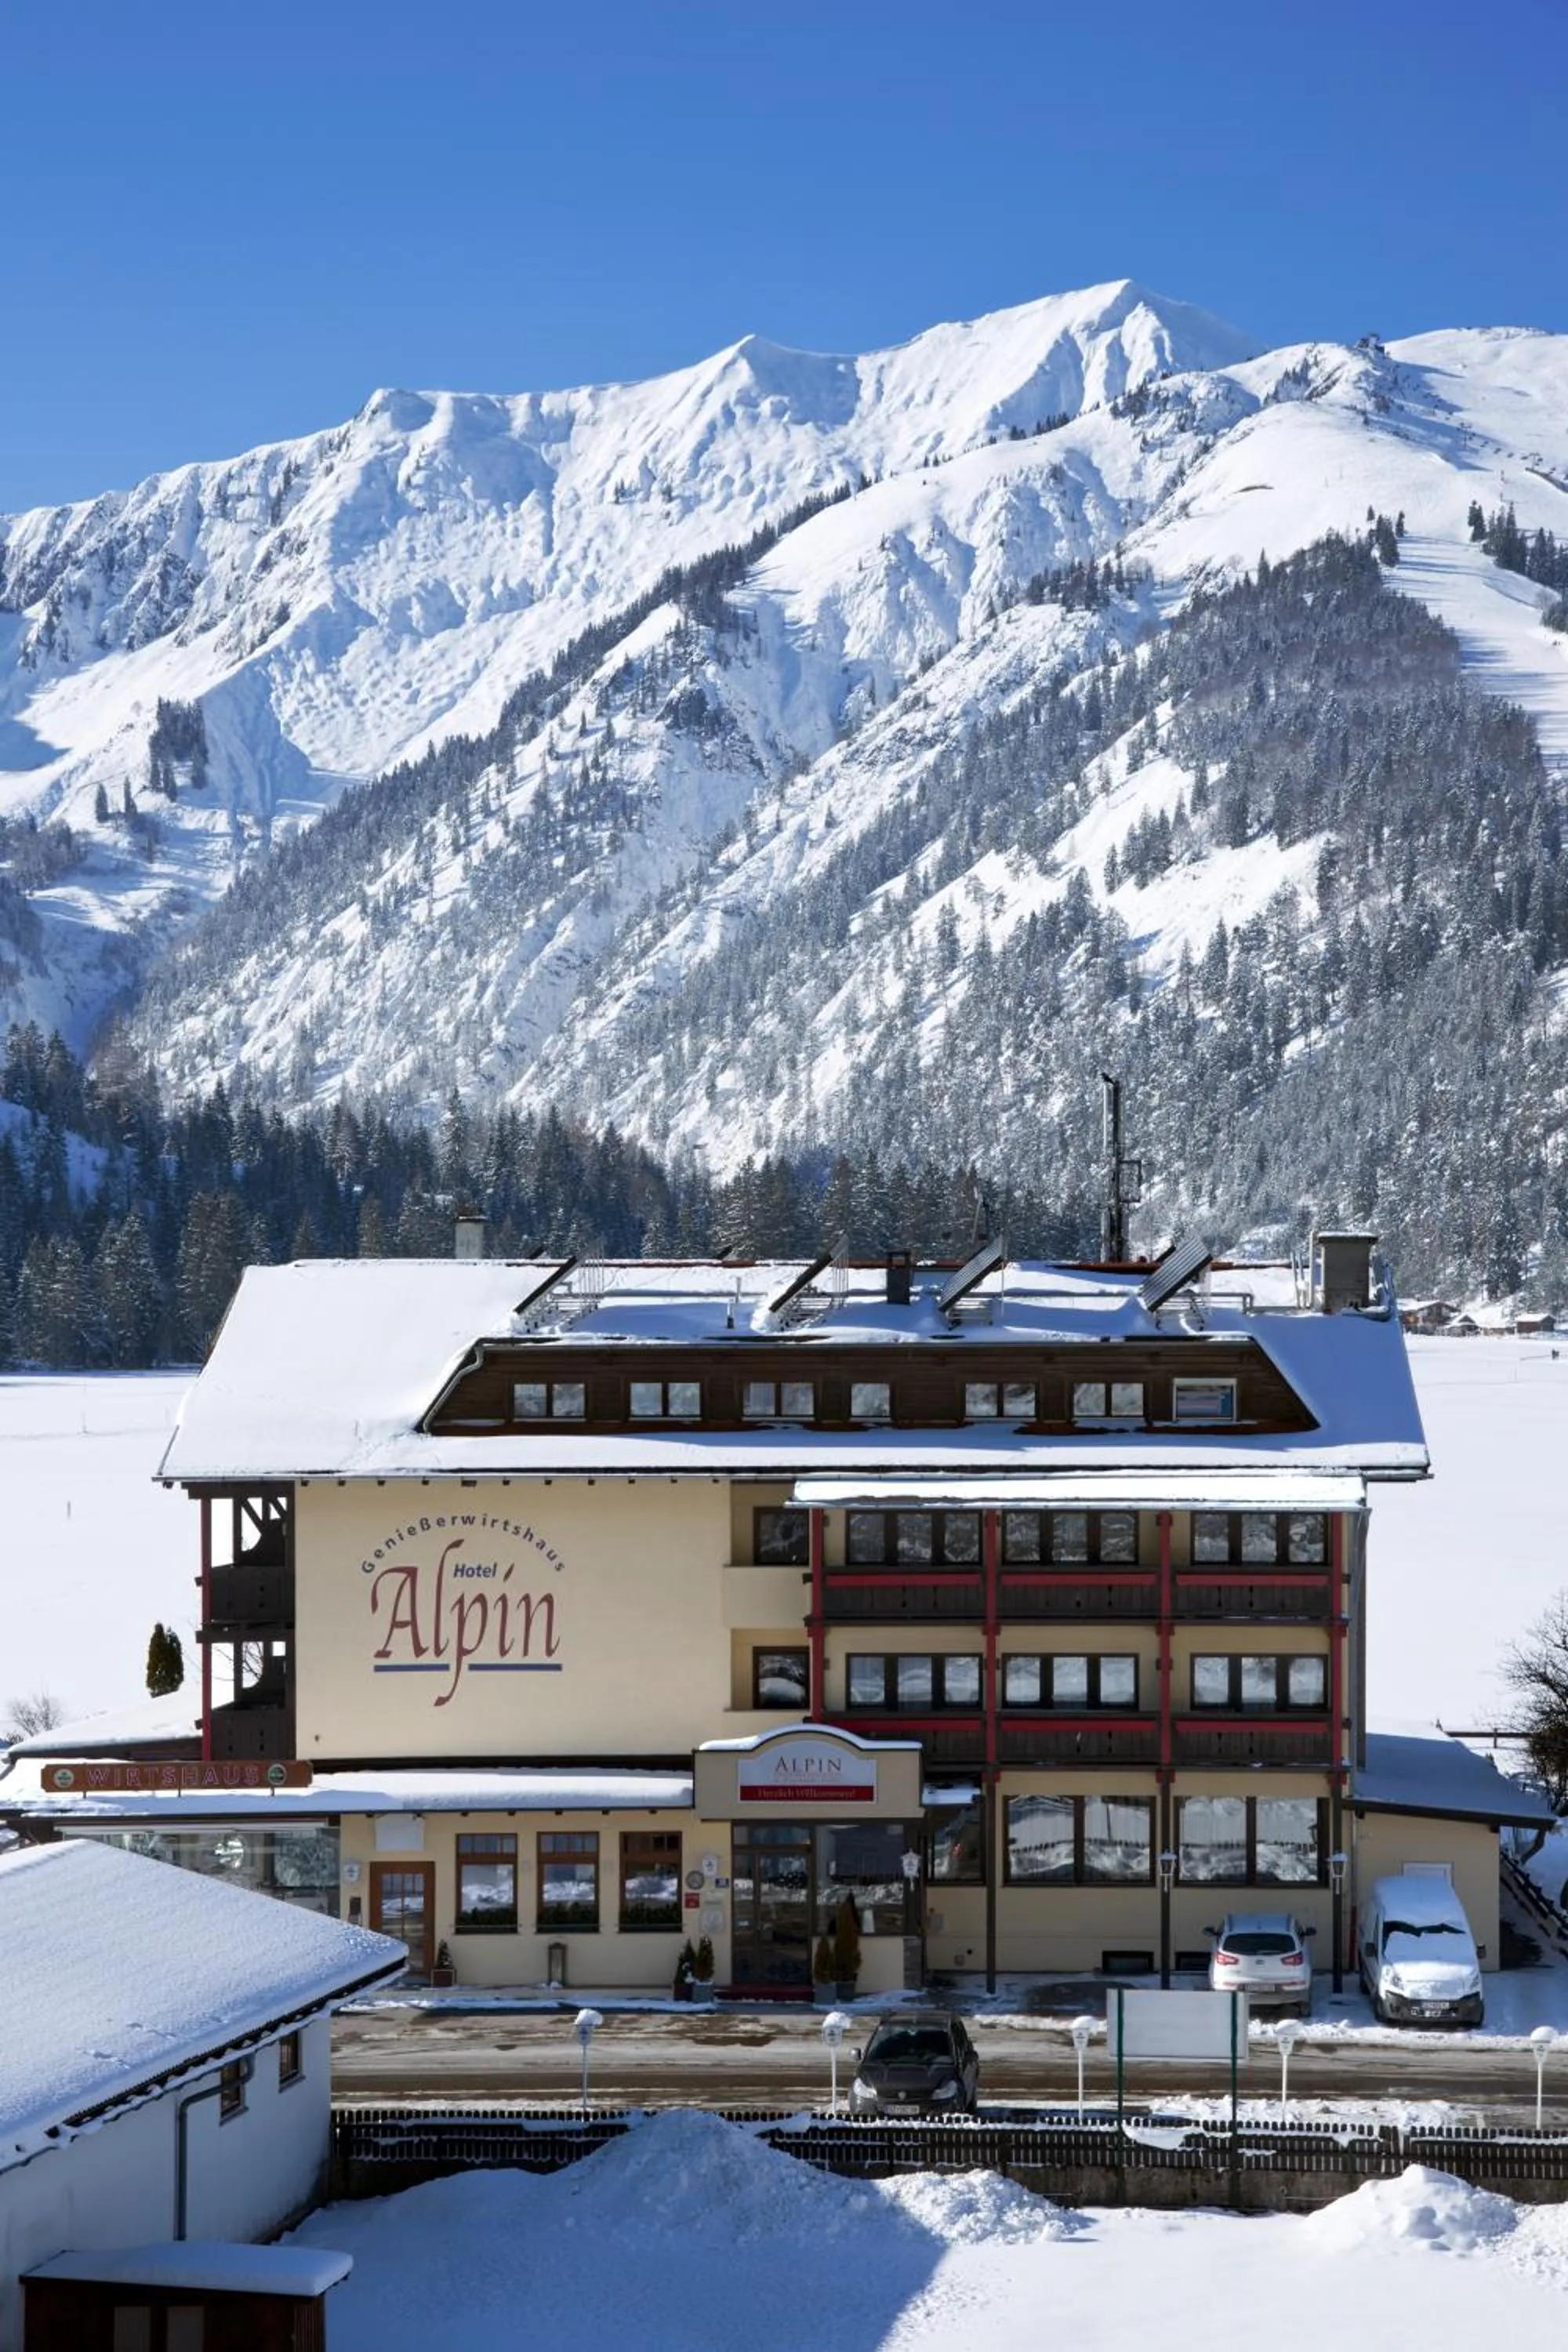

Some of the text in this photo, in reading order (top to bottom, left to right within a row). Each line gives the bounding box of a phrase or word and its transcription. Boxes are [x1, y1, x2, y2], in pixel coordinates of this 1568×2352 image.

[361, 1513, 565, 1574] Genießerwirtshaus
[452, 1563, 498, 1578] Hotel
[371, 1538, 561, 1707] Alpin
[775, 1755, 842, 1773] ALPIN
[85, 1766, 260, 1787] WIRTSHAUS
